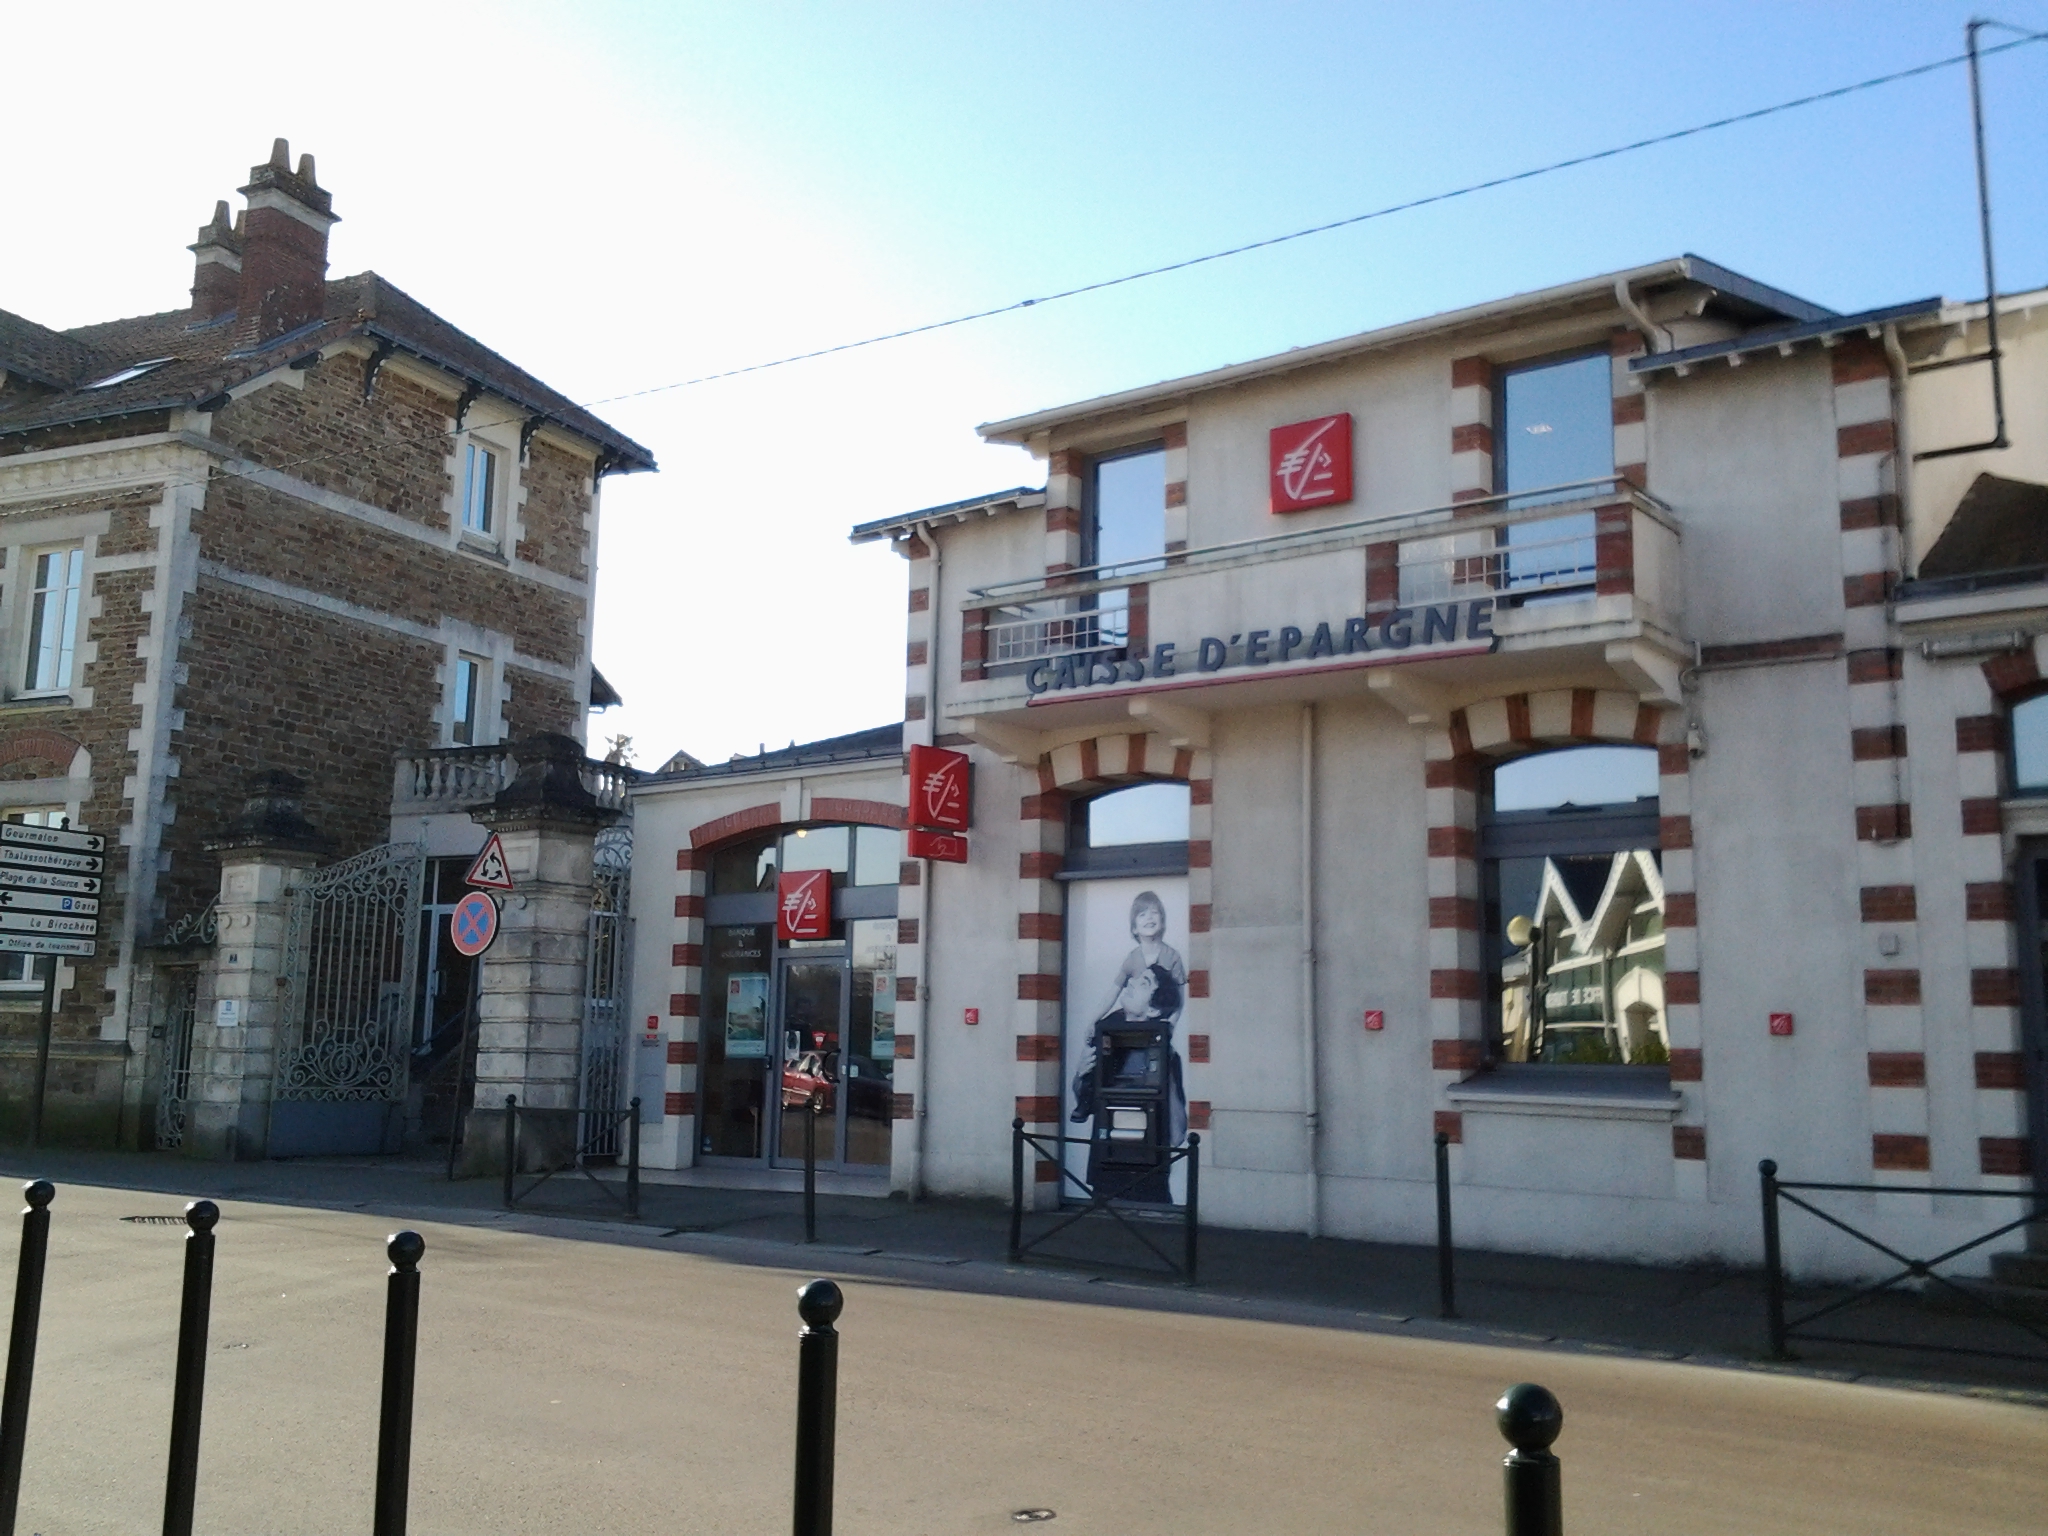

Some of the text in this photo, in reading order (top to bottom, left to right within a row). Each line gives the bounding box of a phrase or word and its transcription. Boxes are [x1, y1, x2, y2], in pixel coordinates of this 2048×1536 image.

[1026, 642, 1176, 694] CAISSE
[4, 849, 82, 868] Thalassothérapie
[0, 871, 79, 888] Plage de la Source
[74, 900, 96, 911] Gare
[30, 917, 94, 932] La Birochère
[35, 941, 45, 949] de
